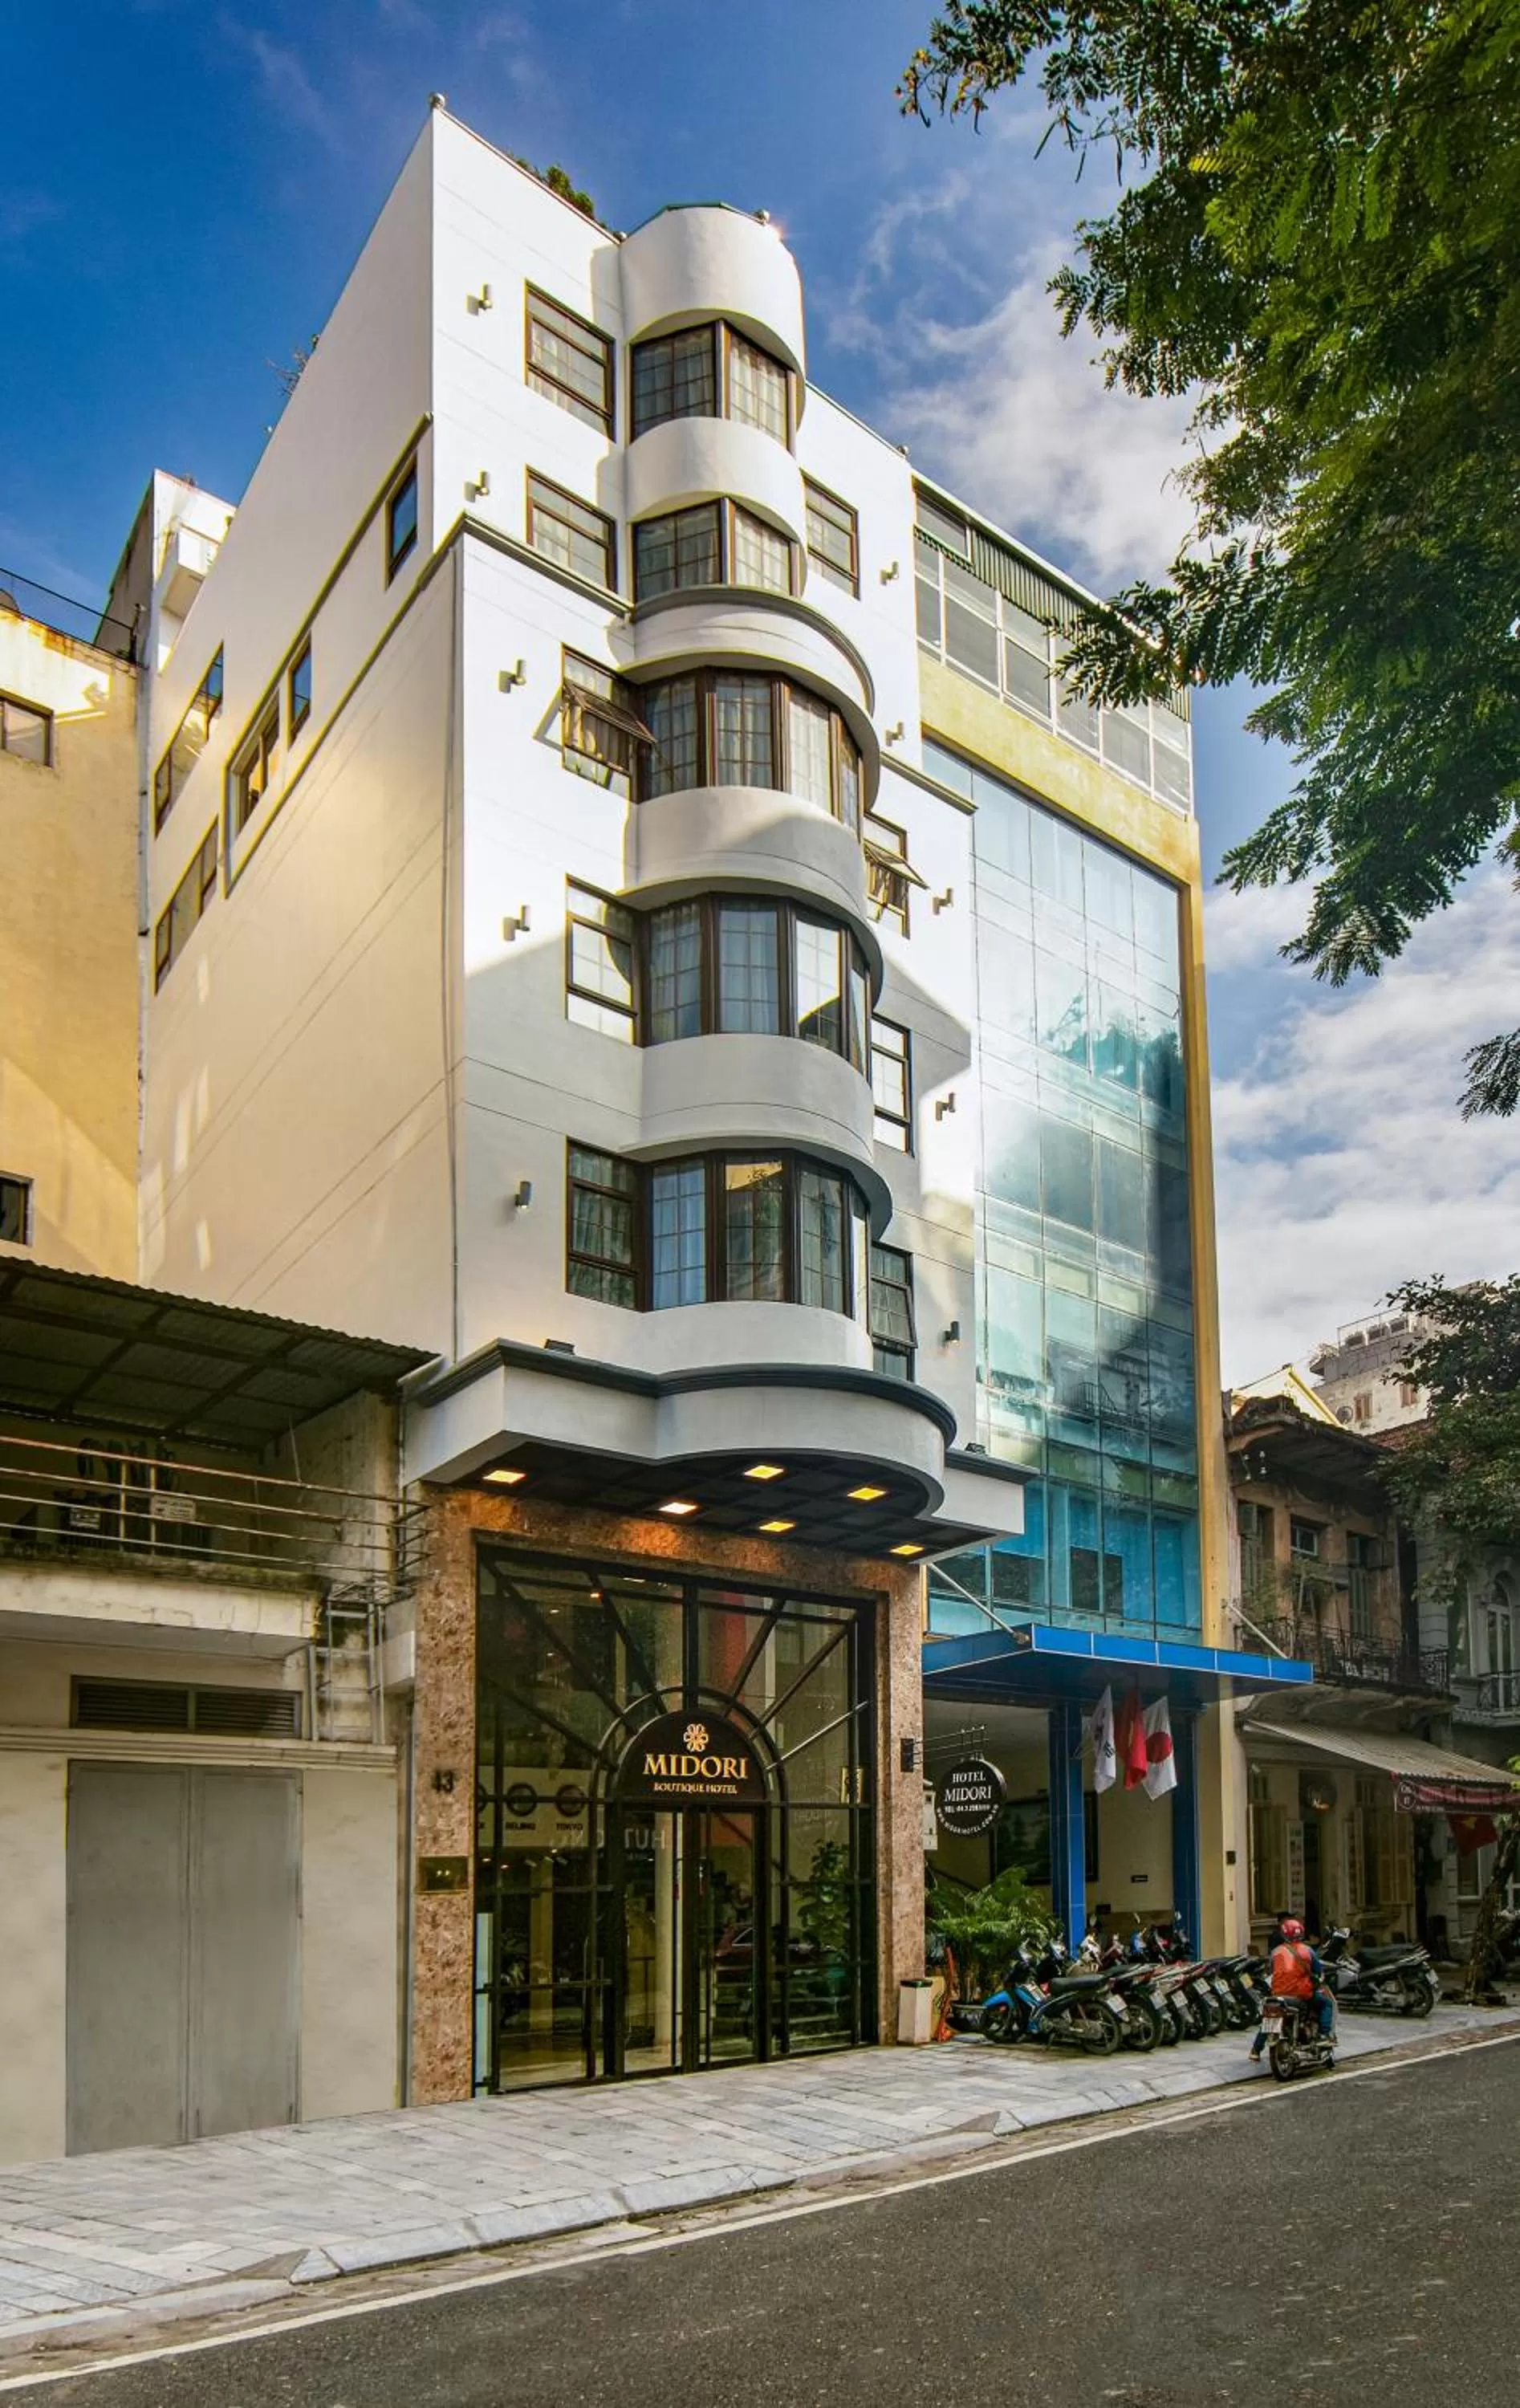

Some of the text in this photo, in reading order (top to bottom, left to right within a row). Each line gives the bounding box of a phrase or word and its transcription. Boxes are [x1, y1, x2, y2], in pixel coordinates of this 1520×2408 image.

[642, 1753, 749, 1780] MIDORI
[431, 1770, 453, 1793] 43
[953, 1771, 986, 1783] HOTEL
[654, 1782, 738, 1794] BOUTIQUE HOTEL
[944, 1785, 992, 1802] MIDORI
[556, 1823, 583, 1831] TOKYO
